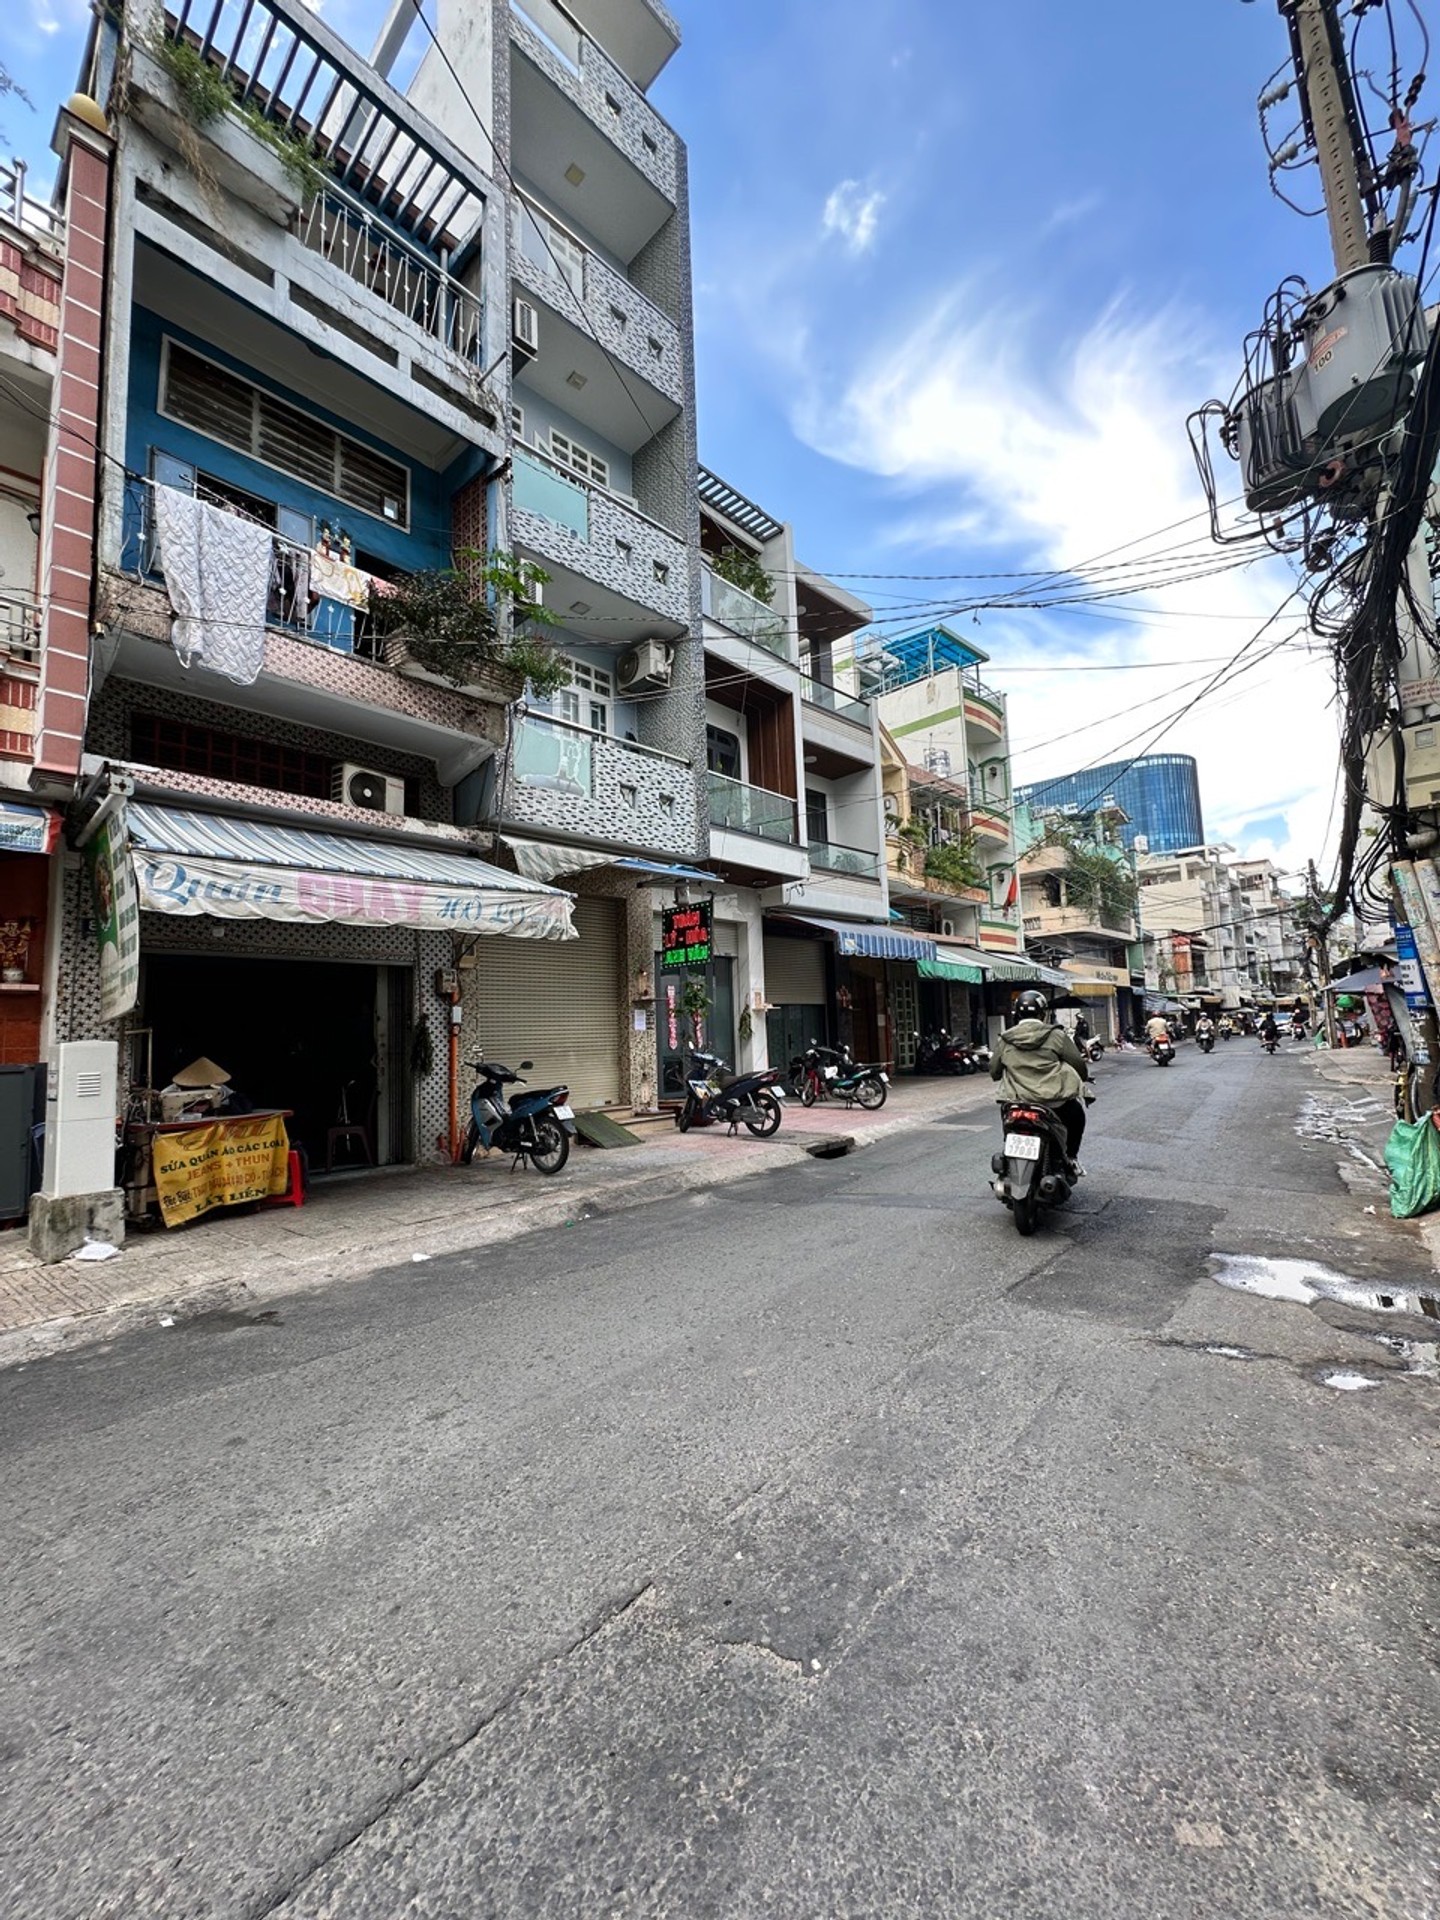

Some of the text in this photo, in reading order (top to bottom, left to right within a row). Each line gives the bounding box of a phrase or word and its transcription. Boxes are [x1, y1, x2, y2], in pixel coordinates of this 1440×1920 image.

[1315, 351, 1332, 372] 100
[144, 861, 283, 907] Quán
[297, 872, 426, 921] CHAY
[672, 910, 700, 929] TOÁN
[686, 926, 708, 945] HÓA
[186, 1160, 222, 1181] JEANS
[236, 1153, 270, 1167] THUN
